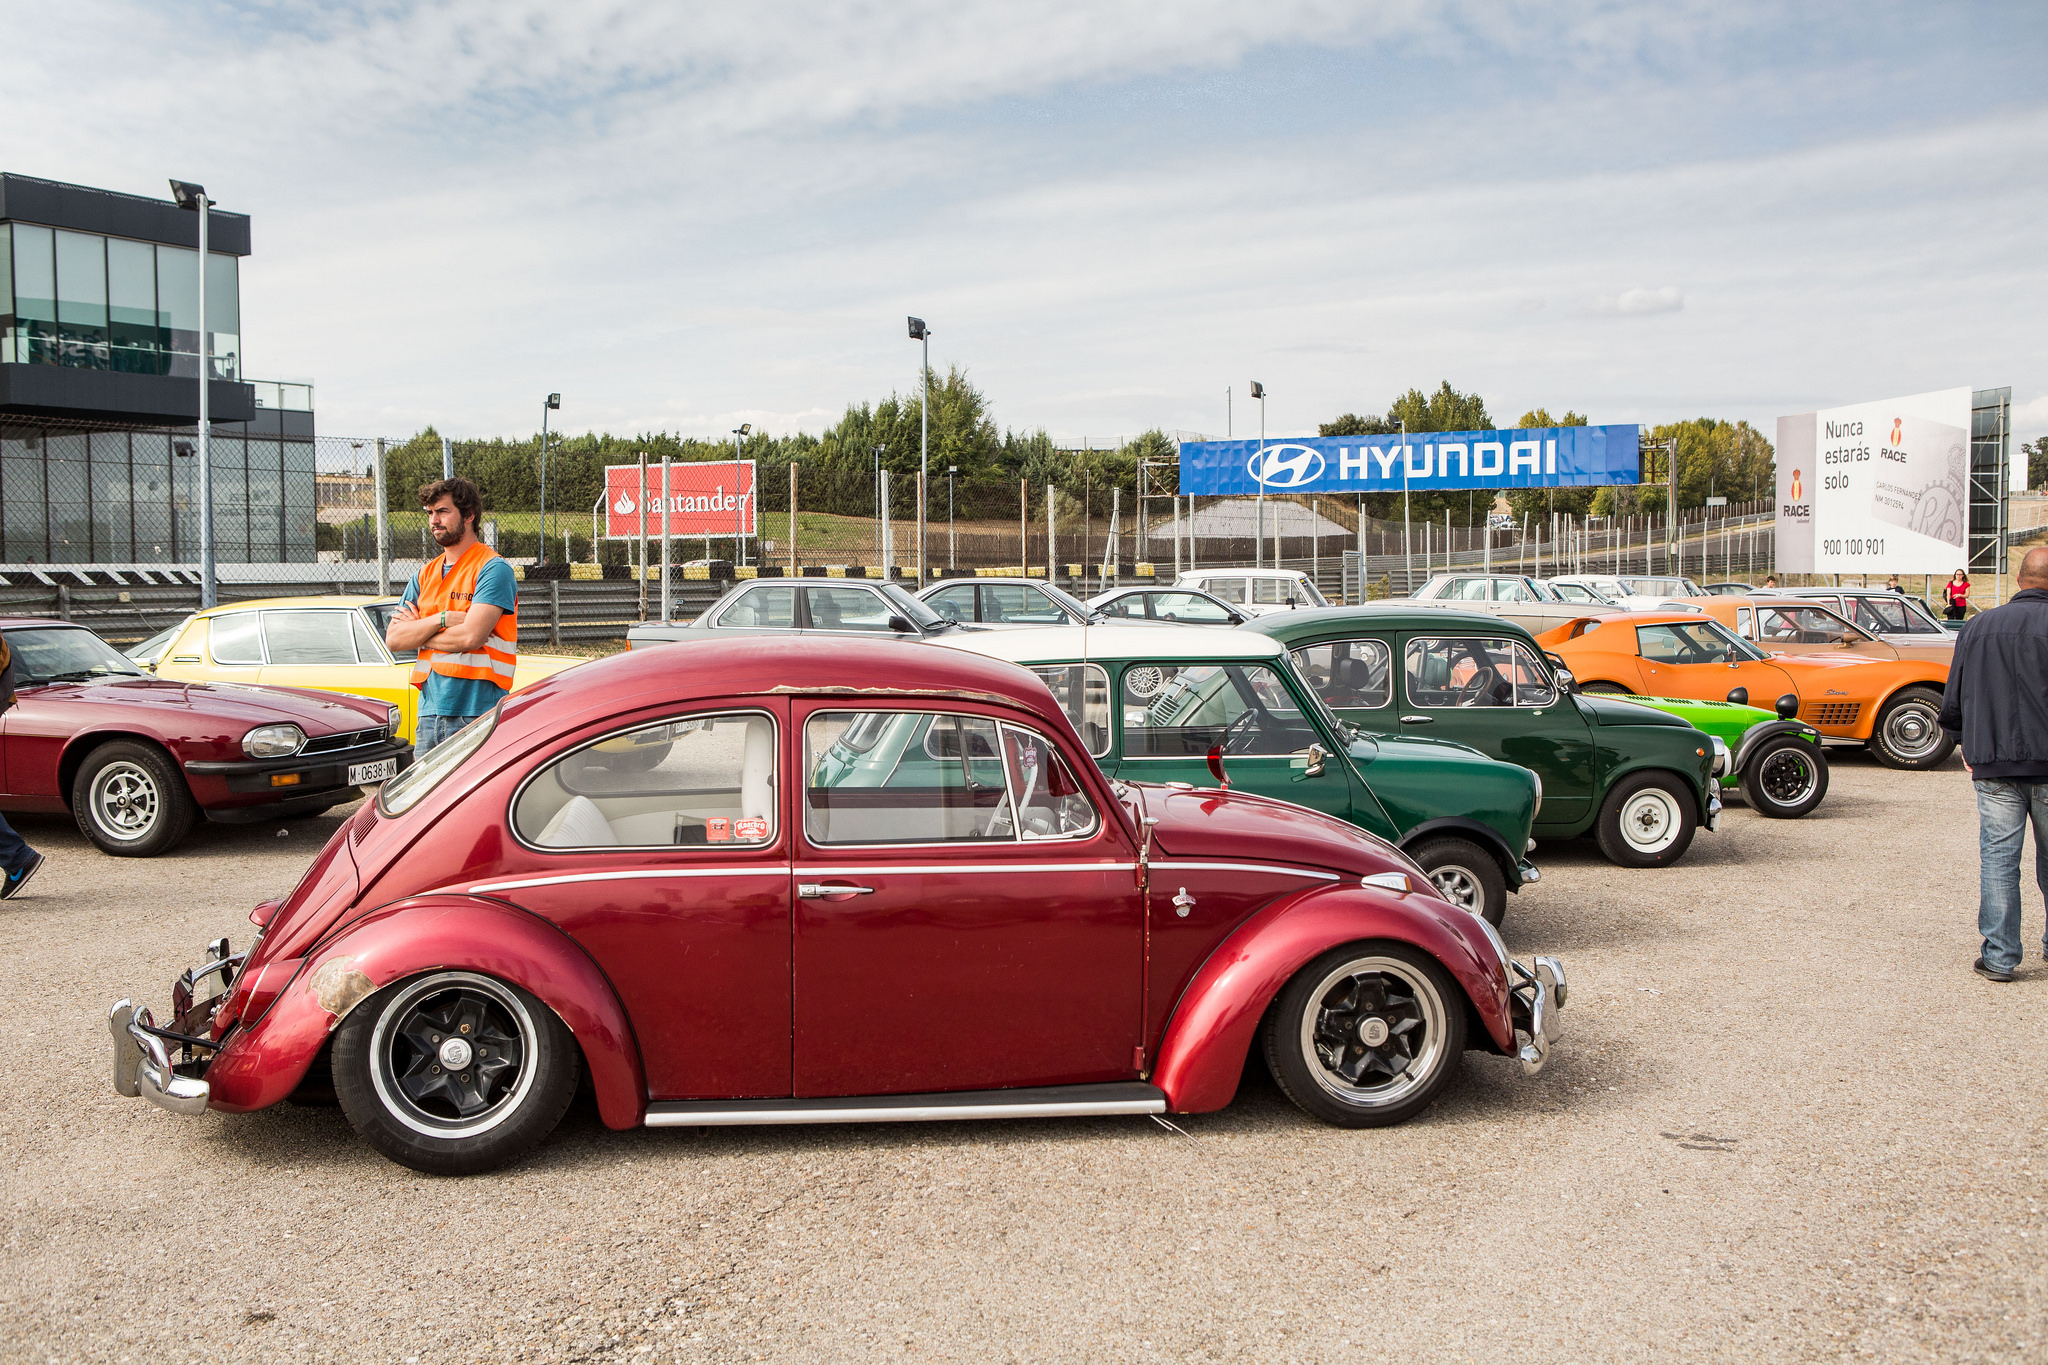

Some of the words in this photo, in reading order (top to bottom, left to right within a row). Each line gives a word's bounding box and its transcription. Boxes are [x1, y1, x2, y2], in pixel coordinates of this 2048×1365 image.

[1825, 420, 1863, 440] Nunca
[1339, 440, 1556, 480] HYUNDAI
[1825, 441, 1870, 465] estarás
[1880, 447, 1907, 464] RACE
[1824, 470, 1849, 490] solo
[1783, 504, 1810, 517] RACE
[1823, 539, 1842, 555] 900
[1844, 539, 1863, 555] 100
[1865, 538, 1884, 555] 901
[450, 591, 474, 601] ONTRO
